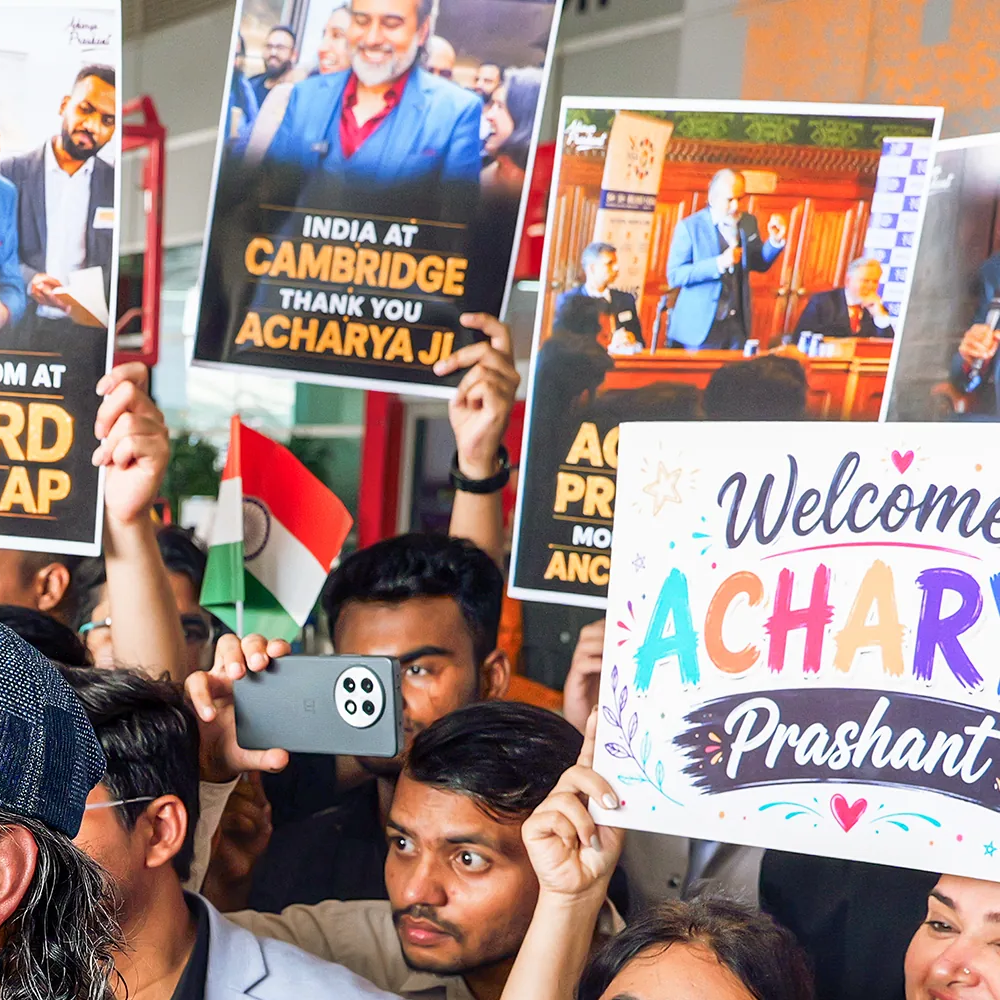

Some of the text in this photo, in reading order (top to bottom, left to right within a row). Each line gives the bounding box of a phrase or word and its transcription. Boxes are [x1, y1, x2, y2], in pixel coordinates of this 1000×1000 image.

[302, 214, 419, 247] INDIA AT
[244, 237, 469, 297] CAMBRIDGE
[279, 288, 423, 323] THANK YOU
[234, 311, 456, 366] ACHARYA JI
[32, 363, 66, 388] AT
[723, 697, 1000, 786] Prashant
